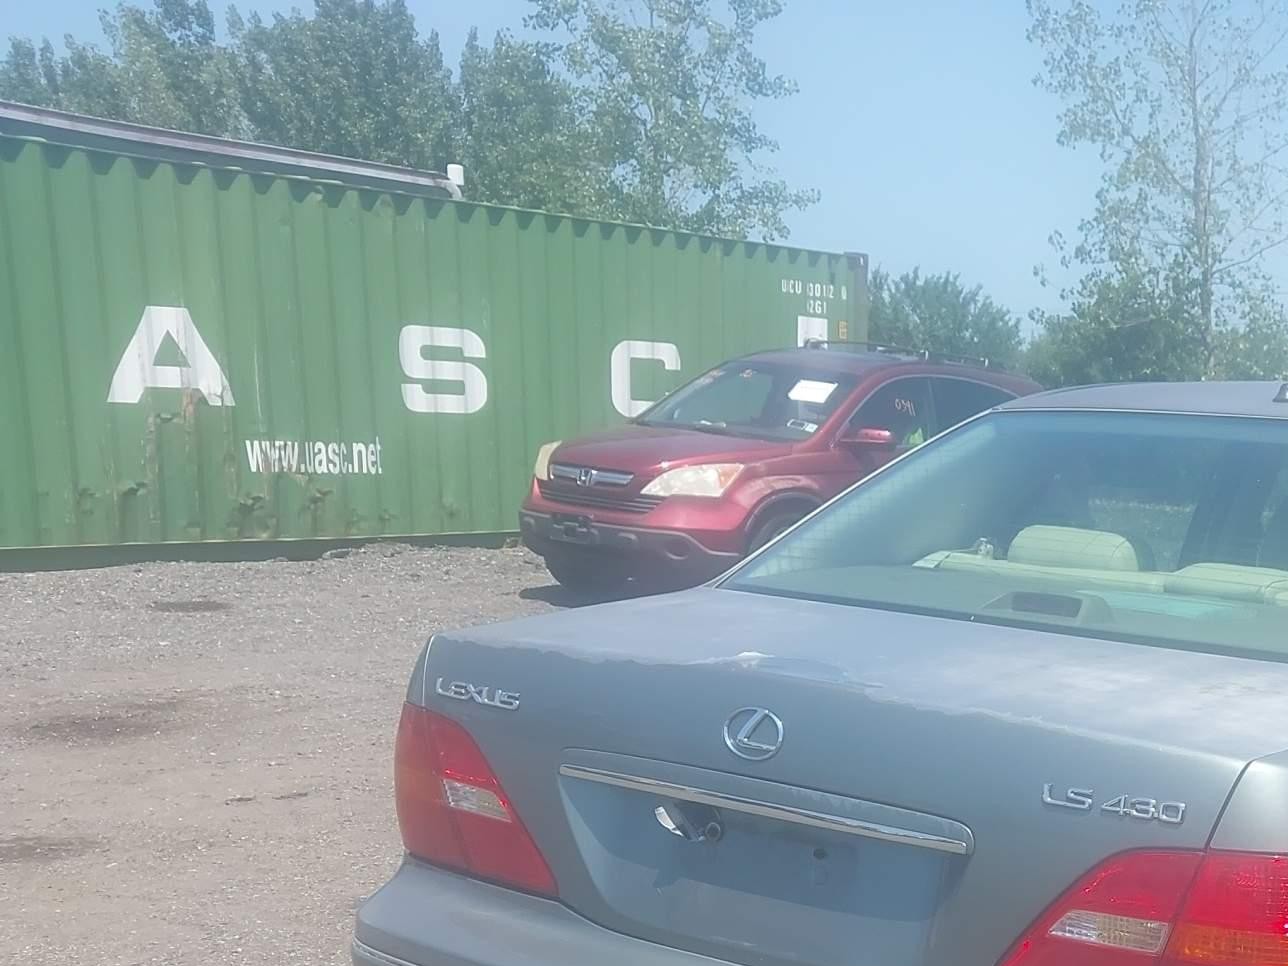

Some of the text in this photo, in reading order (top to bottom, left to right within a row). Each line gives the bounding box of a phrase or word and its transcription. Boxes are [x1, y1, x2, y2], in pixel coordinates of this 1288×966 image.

[245, 436, 382, 474] www.uasc.net
[436, 678, 520, 711] LEXUS
[1042, 783, 1186, 824] LS 430
